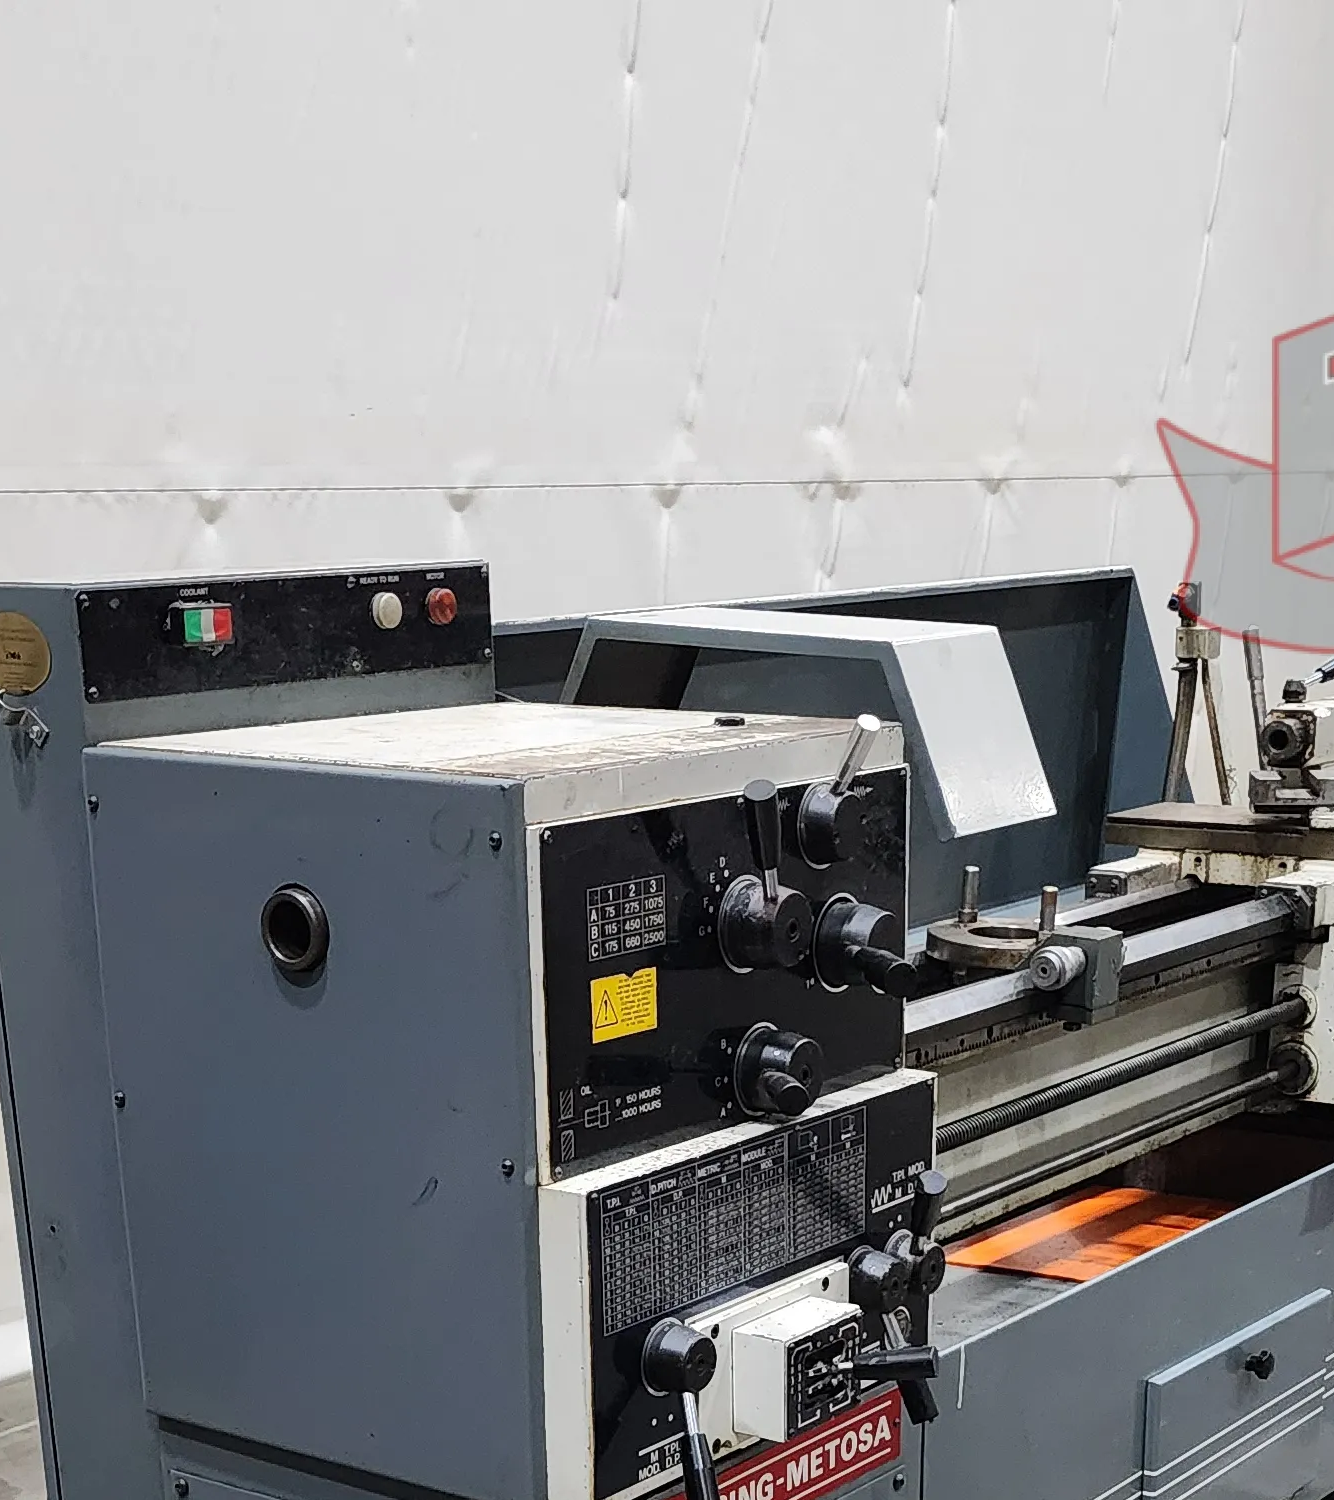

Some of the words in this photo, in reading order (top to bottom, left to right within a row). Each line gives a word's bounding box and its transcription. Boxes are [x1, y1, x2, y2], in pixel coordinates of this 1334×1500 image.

[179, 586, 209, 597] COOLANT
[628, 884, 636, 897] 2
[649, 879, 657, 893] 3
[590, 909, 598, 922] A
[605, 906, 616, 918] 75
[624, 901, 640, 914] 275
[644, 896, 663, 910] 1075
[591, 926, 598, 939] B
[604, 923, 617, 935] 115
[624, 919, 641, 931] 450
[644, 914, 663, 926] 1750
[591, 943, 599, 957] C
[605, 940, 618, 952] 175
[625, 936, 641, 948] 660
[644, 931, 664, 944] 2500
[580, 1085, 593, 1096] OIL
[626, 1093, 638, 1104] 150
[638, 1085, 662, 1100] HOURS
[621, 1106, 638, 1118] 1000
[639, 1099, 662, 1113] HOURS
[697, 1162, 722, 1178] METRIC
[741, 1146, 768, 1162] MODULE
[894, 1187, 902, 1199] M
[650, 1449, 659, 1464] M
[638, 1462, 661, 1481] MOD.
[665, 1452, 682, 1469] D.P.
